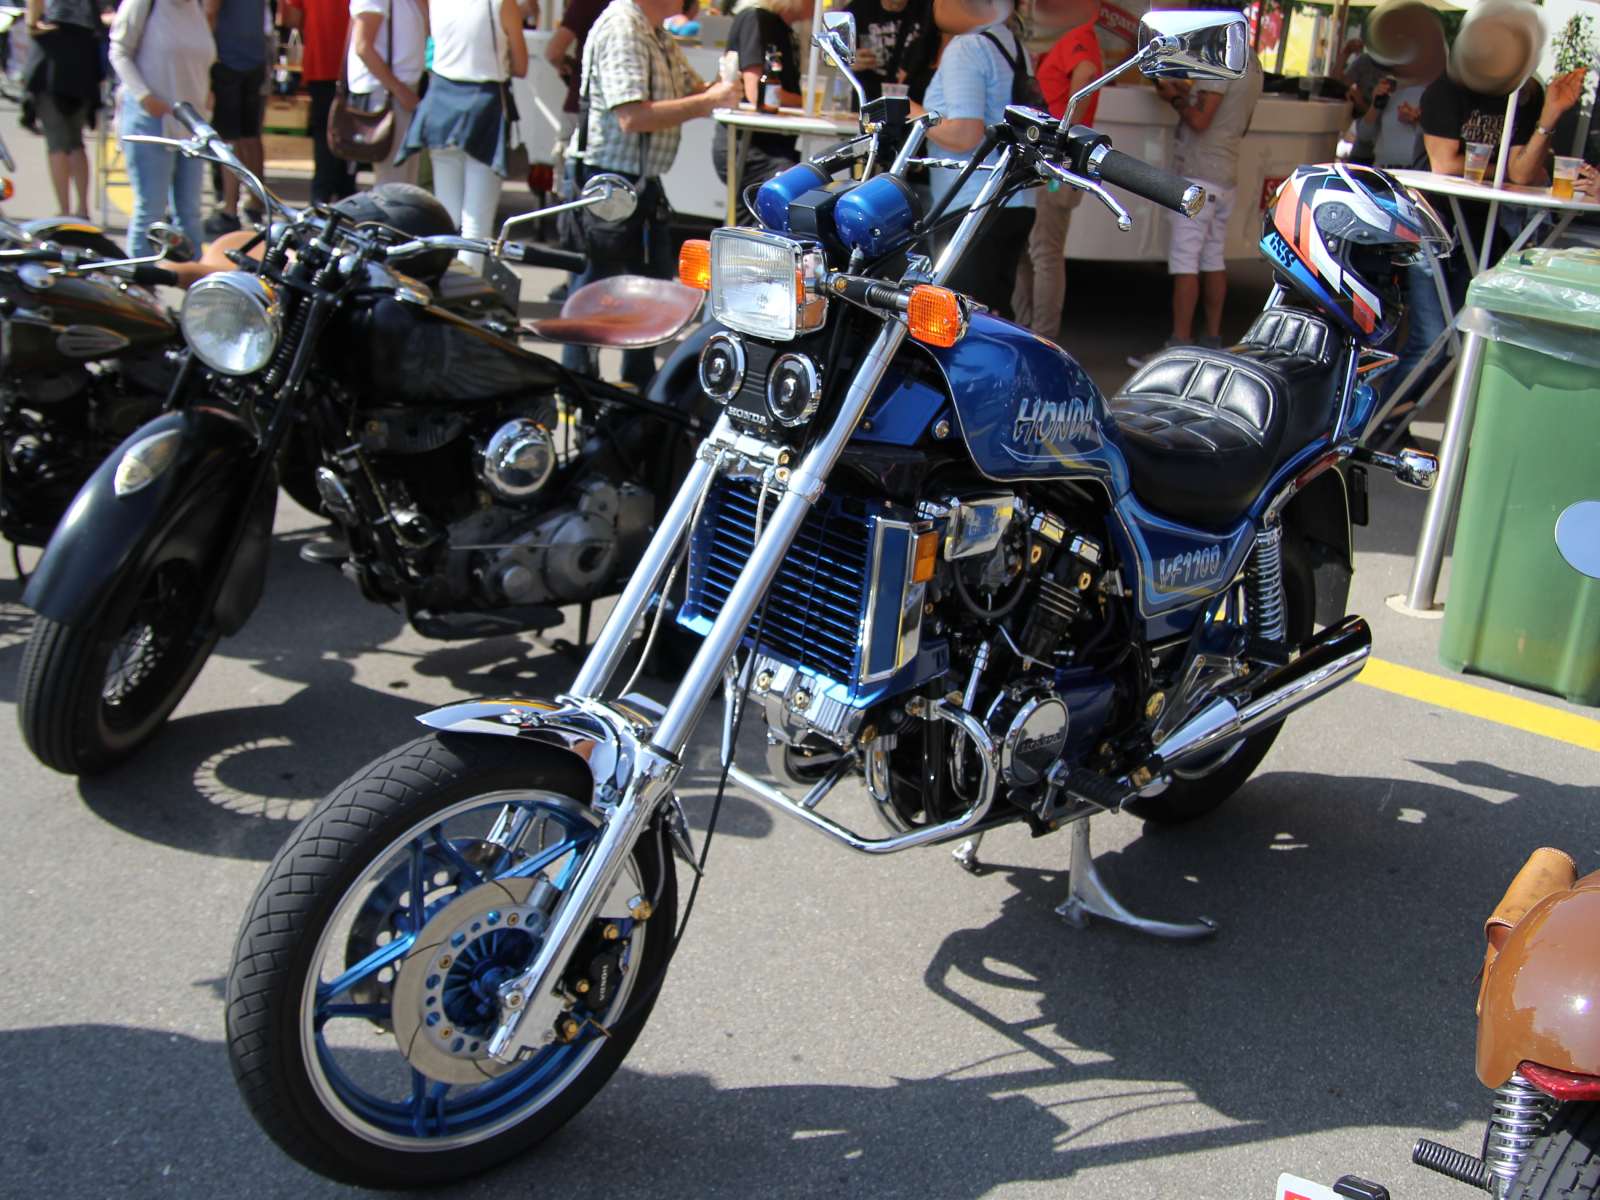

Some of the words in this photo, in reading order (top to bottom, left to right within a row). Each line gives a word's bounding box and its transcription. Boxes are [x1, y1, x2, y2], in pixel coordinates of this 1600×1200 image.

[727, 405, 768, 426] HONDA
[1013, 396, 1094, 446] HONDA
[1159, 544, 1221, 590] VF1100
[1018, 731, 1063, 755] HONDA
[599, 964, 609, 1001] HONDA
